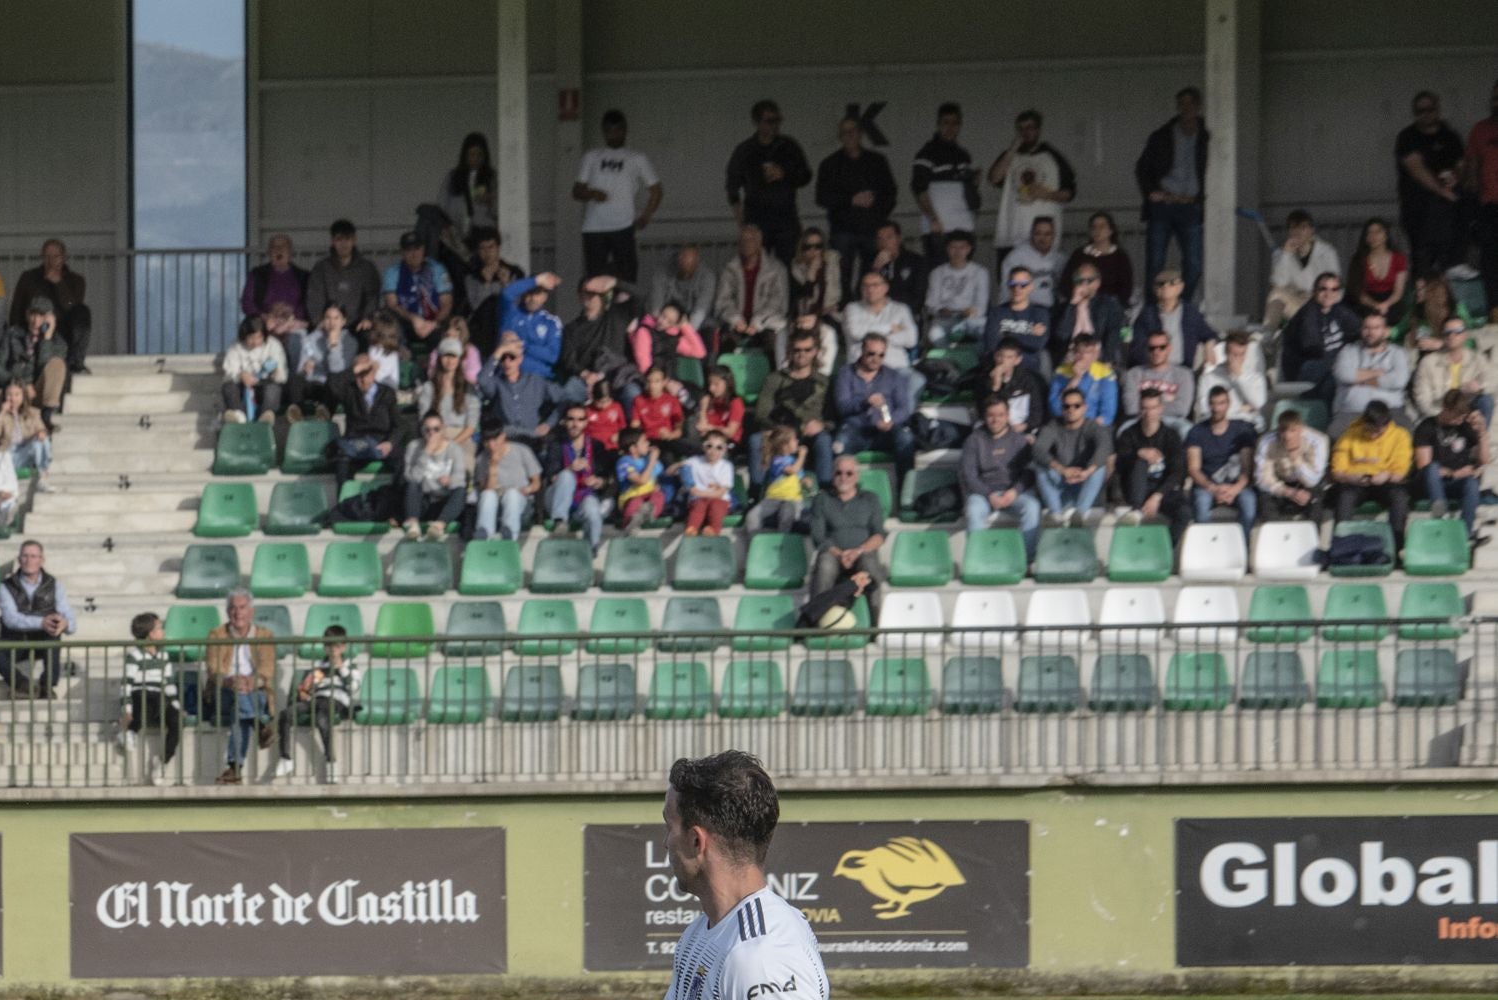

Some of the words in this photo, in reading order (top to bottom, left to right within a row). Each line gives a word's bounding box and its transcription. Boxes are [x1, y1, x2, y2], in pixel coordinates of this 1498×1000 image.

[645, 841, 670, 868] L
[1200, 840, 1498, 907] Global
[96, 881, 150, 928] El
[154, 881, 265, 927] Norte
[269, 883, 313, 926] de
[317, 879, 480, 926] Castilla
[1438, 917, 1498, 939] Info
